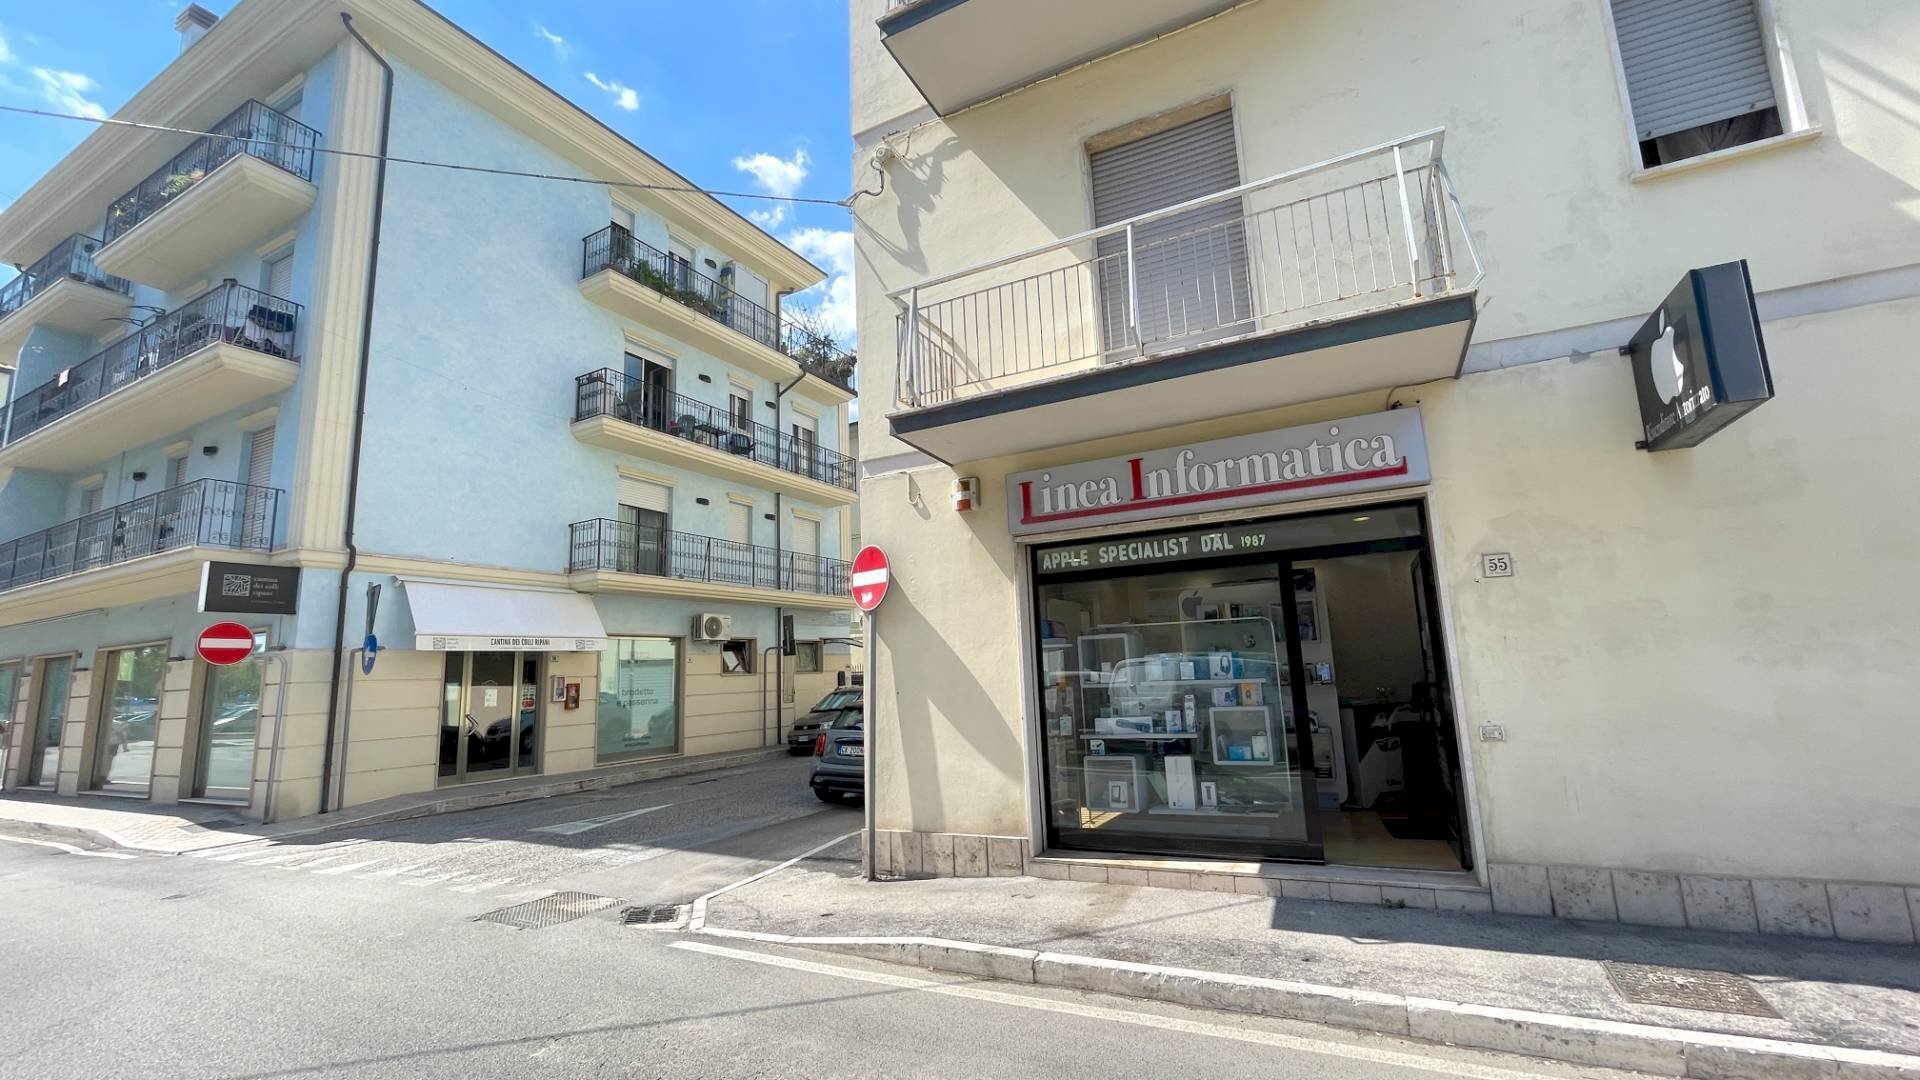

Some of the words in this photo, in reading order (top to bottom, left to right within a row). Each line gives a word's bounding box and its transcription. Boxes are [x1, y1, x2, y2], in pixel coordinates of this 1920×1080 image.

[1018, 472, 1122, 525] Linea
[1127, 425, 1402, 502] Informatica
[1043, 549, 1089, 570] APPLE
[1099, 537, 1190, 564] SPECIALIST
[1200, 532, 1234, 552] DAL
[1240, 534, 1266, 547] 1987
[1488, 557, 1508, 571] 55
[490, 638, 511, 646] CANTINA
[521, 638, 534, 646] COLLI
[534, 638, 551, 646] RIPANI
